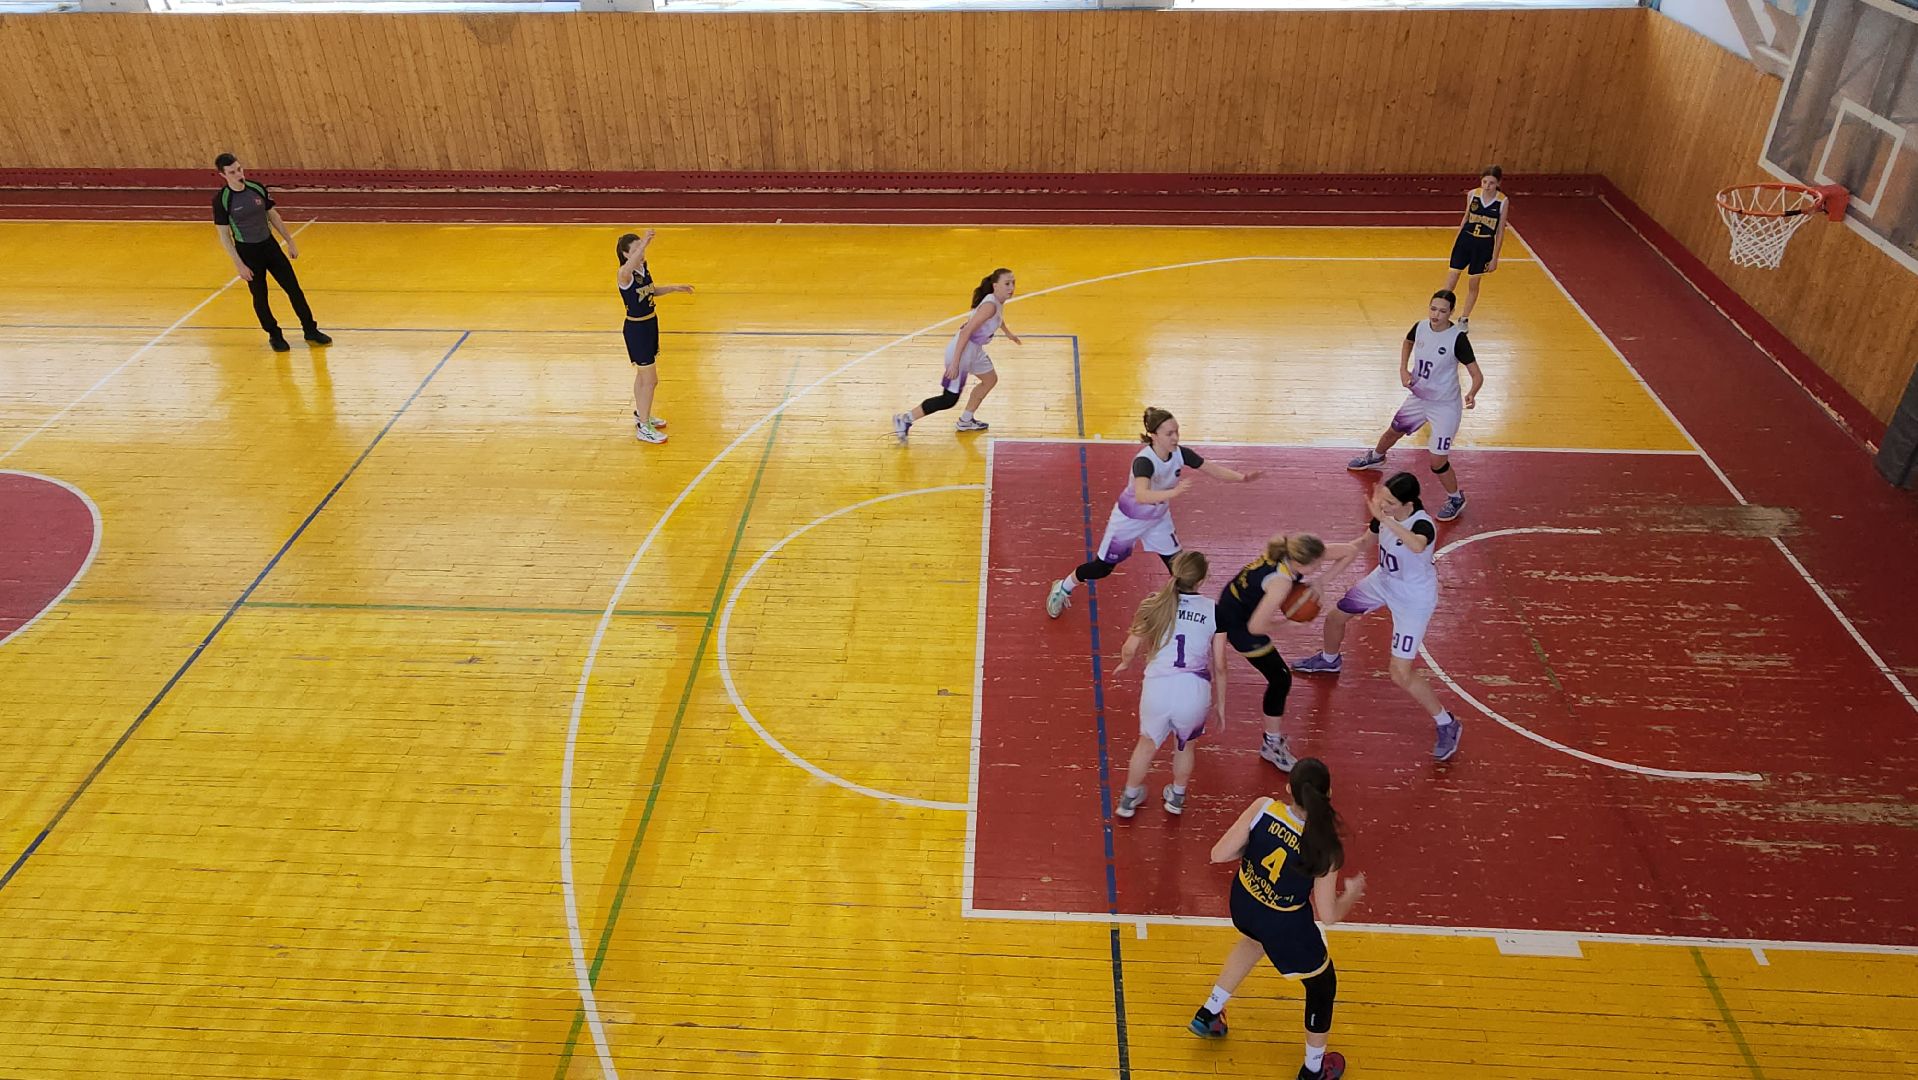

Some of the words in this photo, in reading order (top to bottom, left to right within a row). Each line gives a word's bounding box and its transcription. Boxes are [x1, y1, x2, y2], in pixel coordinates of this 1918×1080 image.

[1473, 224, 1482, 237] 5
[1417, 359, 1433, 380] 16
[1437, 437, 1451, 450] 16
[1173, 634, 1186, 668] 1
[1268, 820, 1300, 854] ЮСОВА
[1261, 847, 1287, 884] 4
